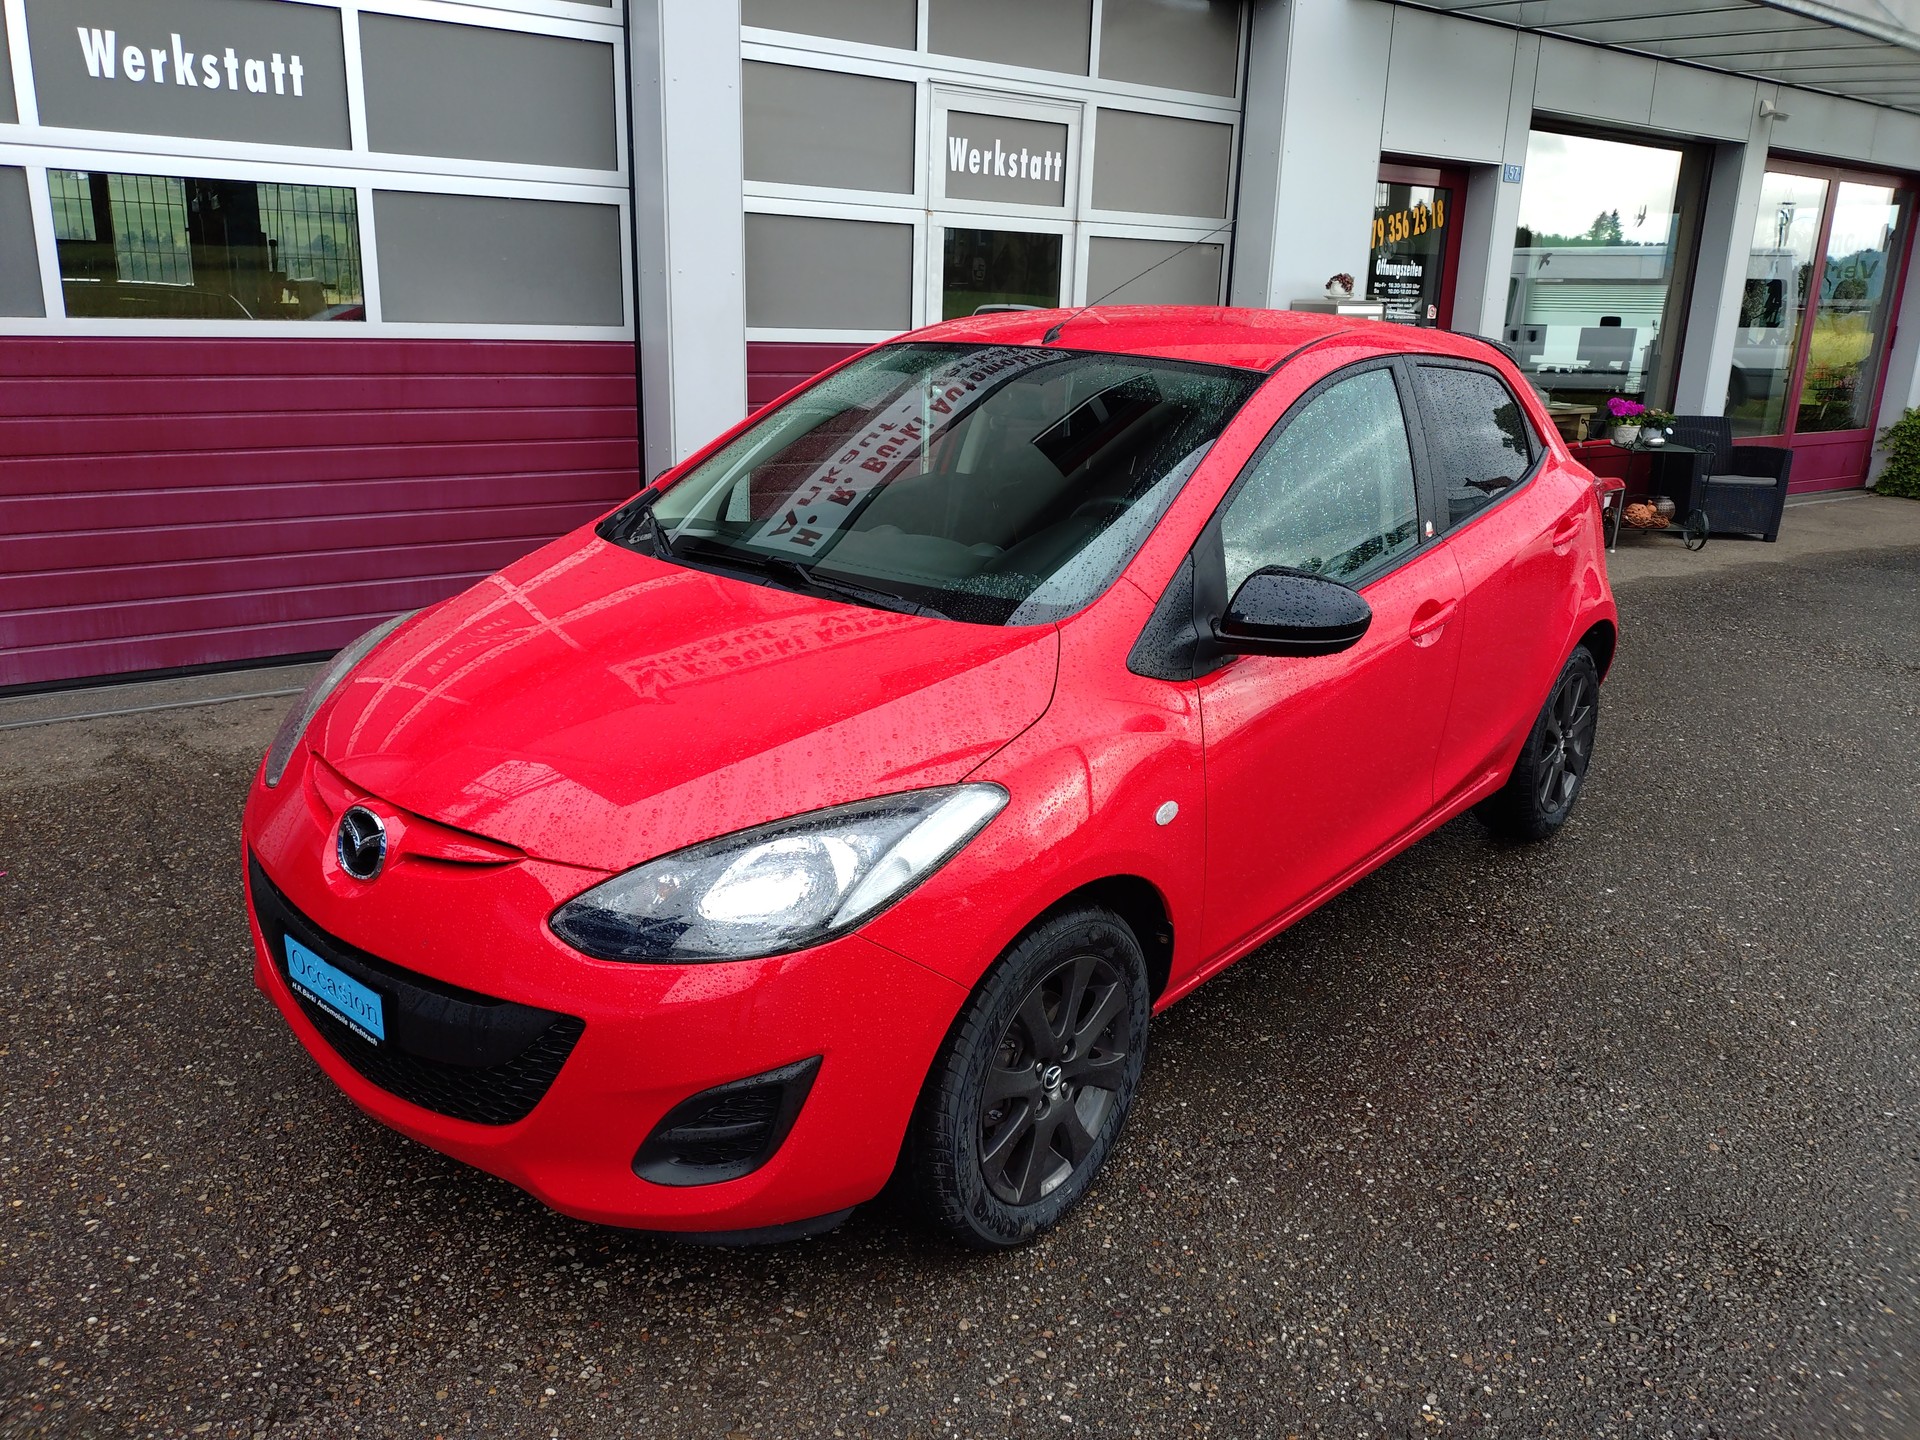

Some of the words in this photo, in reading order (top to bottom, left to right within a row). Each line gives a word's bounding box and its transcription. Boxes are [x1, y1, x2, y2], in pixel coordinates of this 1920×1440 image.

[77, 26, 304, 97] Werkstatt
[948, 136, 1062, 182] Werkstatt
[1508, 166, 1519, 180] 57
[1388, 210, 1410, 243] 356
[1413, 205, 1427, 236] 23
[1431, 199, 1444, 230] 18
[1376, 255, 1423, 279] Öffnungszeiten
[292, 949, 380, 1027] Occasion
[316, 999, 349, 1026] Automobile
[349, 1021, 378, 1047] Wichtrach
